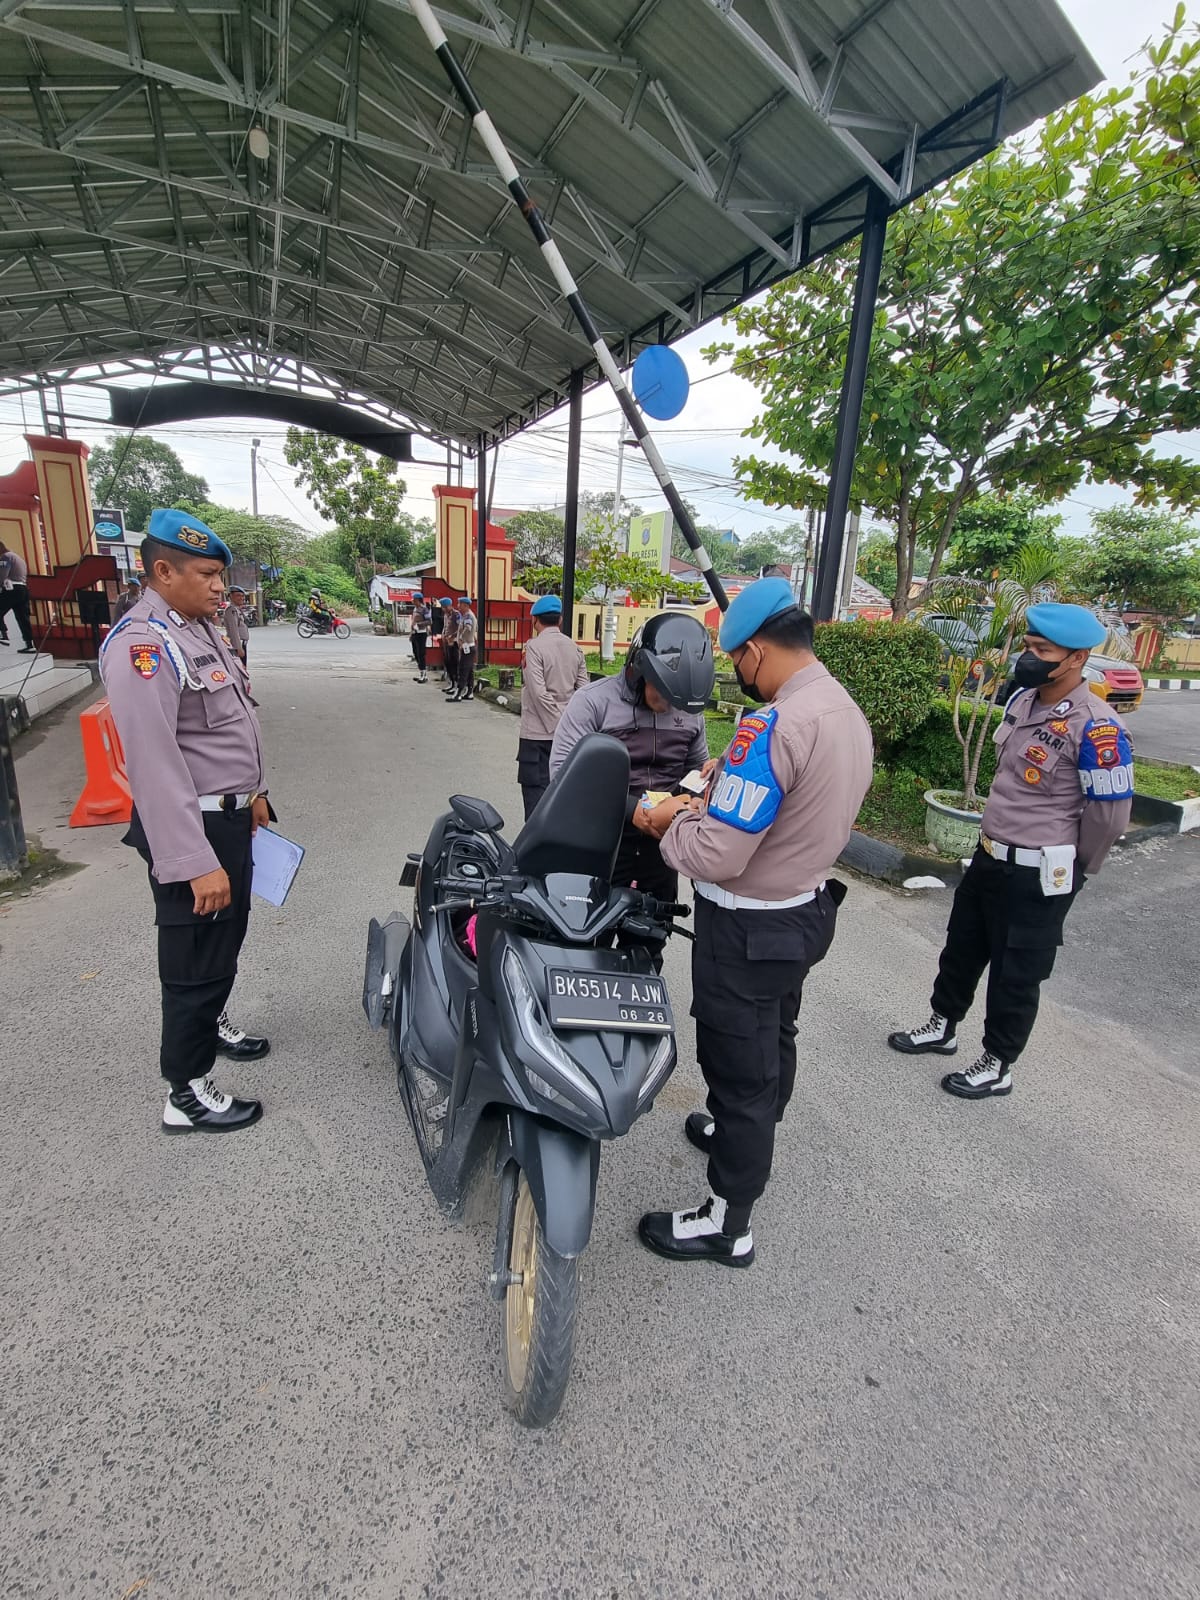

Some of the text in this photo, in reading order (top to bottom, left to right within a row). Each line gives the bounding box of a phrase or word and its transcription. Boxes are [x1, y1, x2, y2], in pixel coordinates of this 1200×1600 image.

[631, 549, 657, 559] POLRESTA
[1032, 728, 1065, 751] POLRI
[565, 895, 593, 904] HONDA
[631, 983, 662, 1004] AJW
[620, 1009, 664, 1023] 06 26
